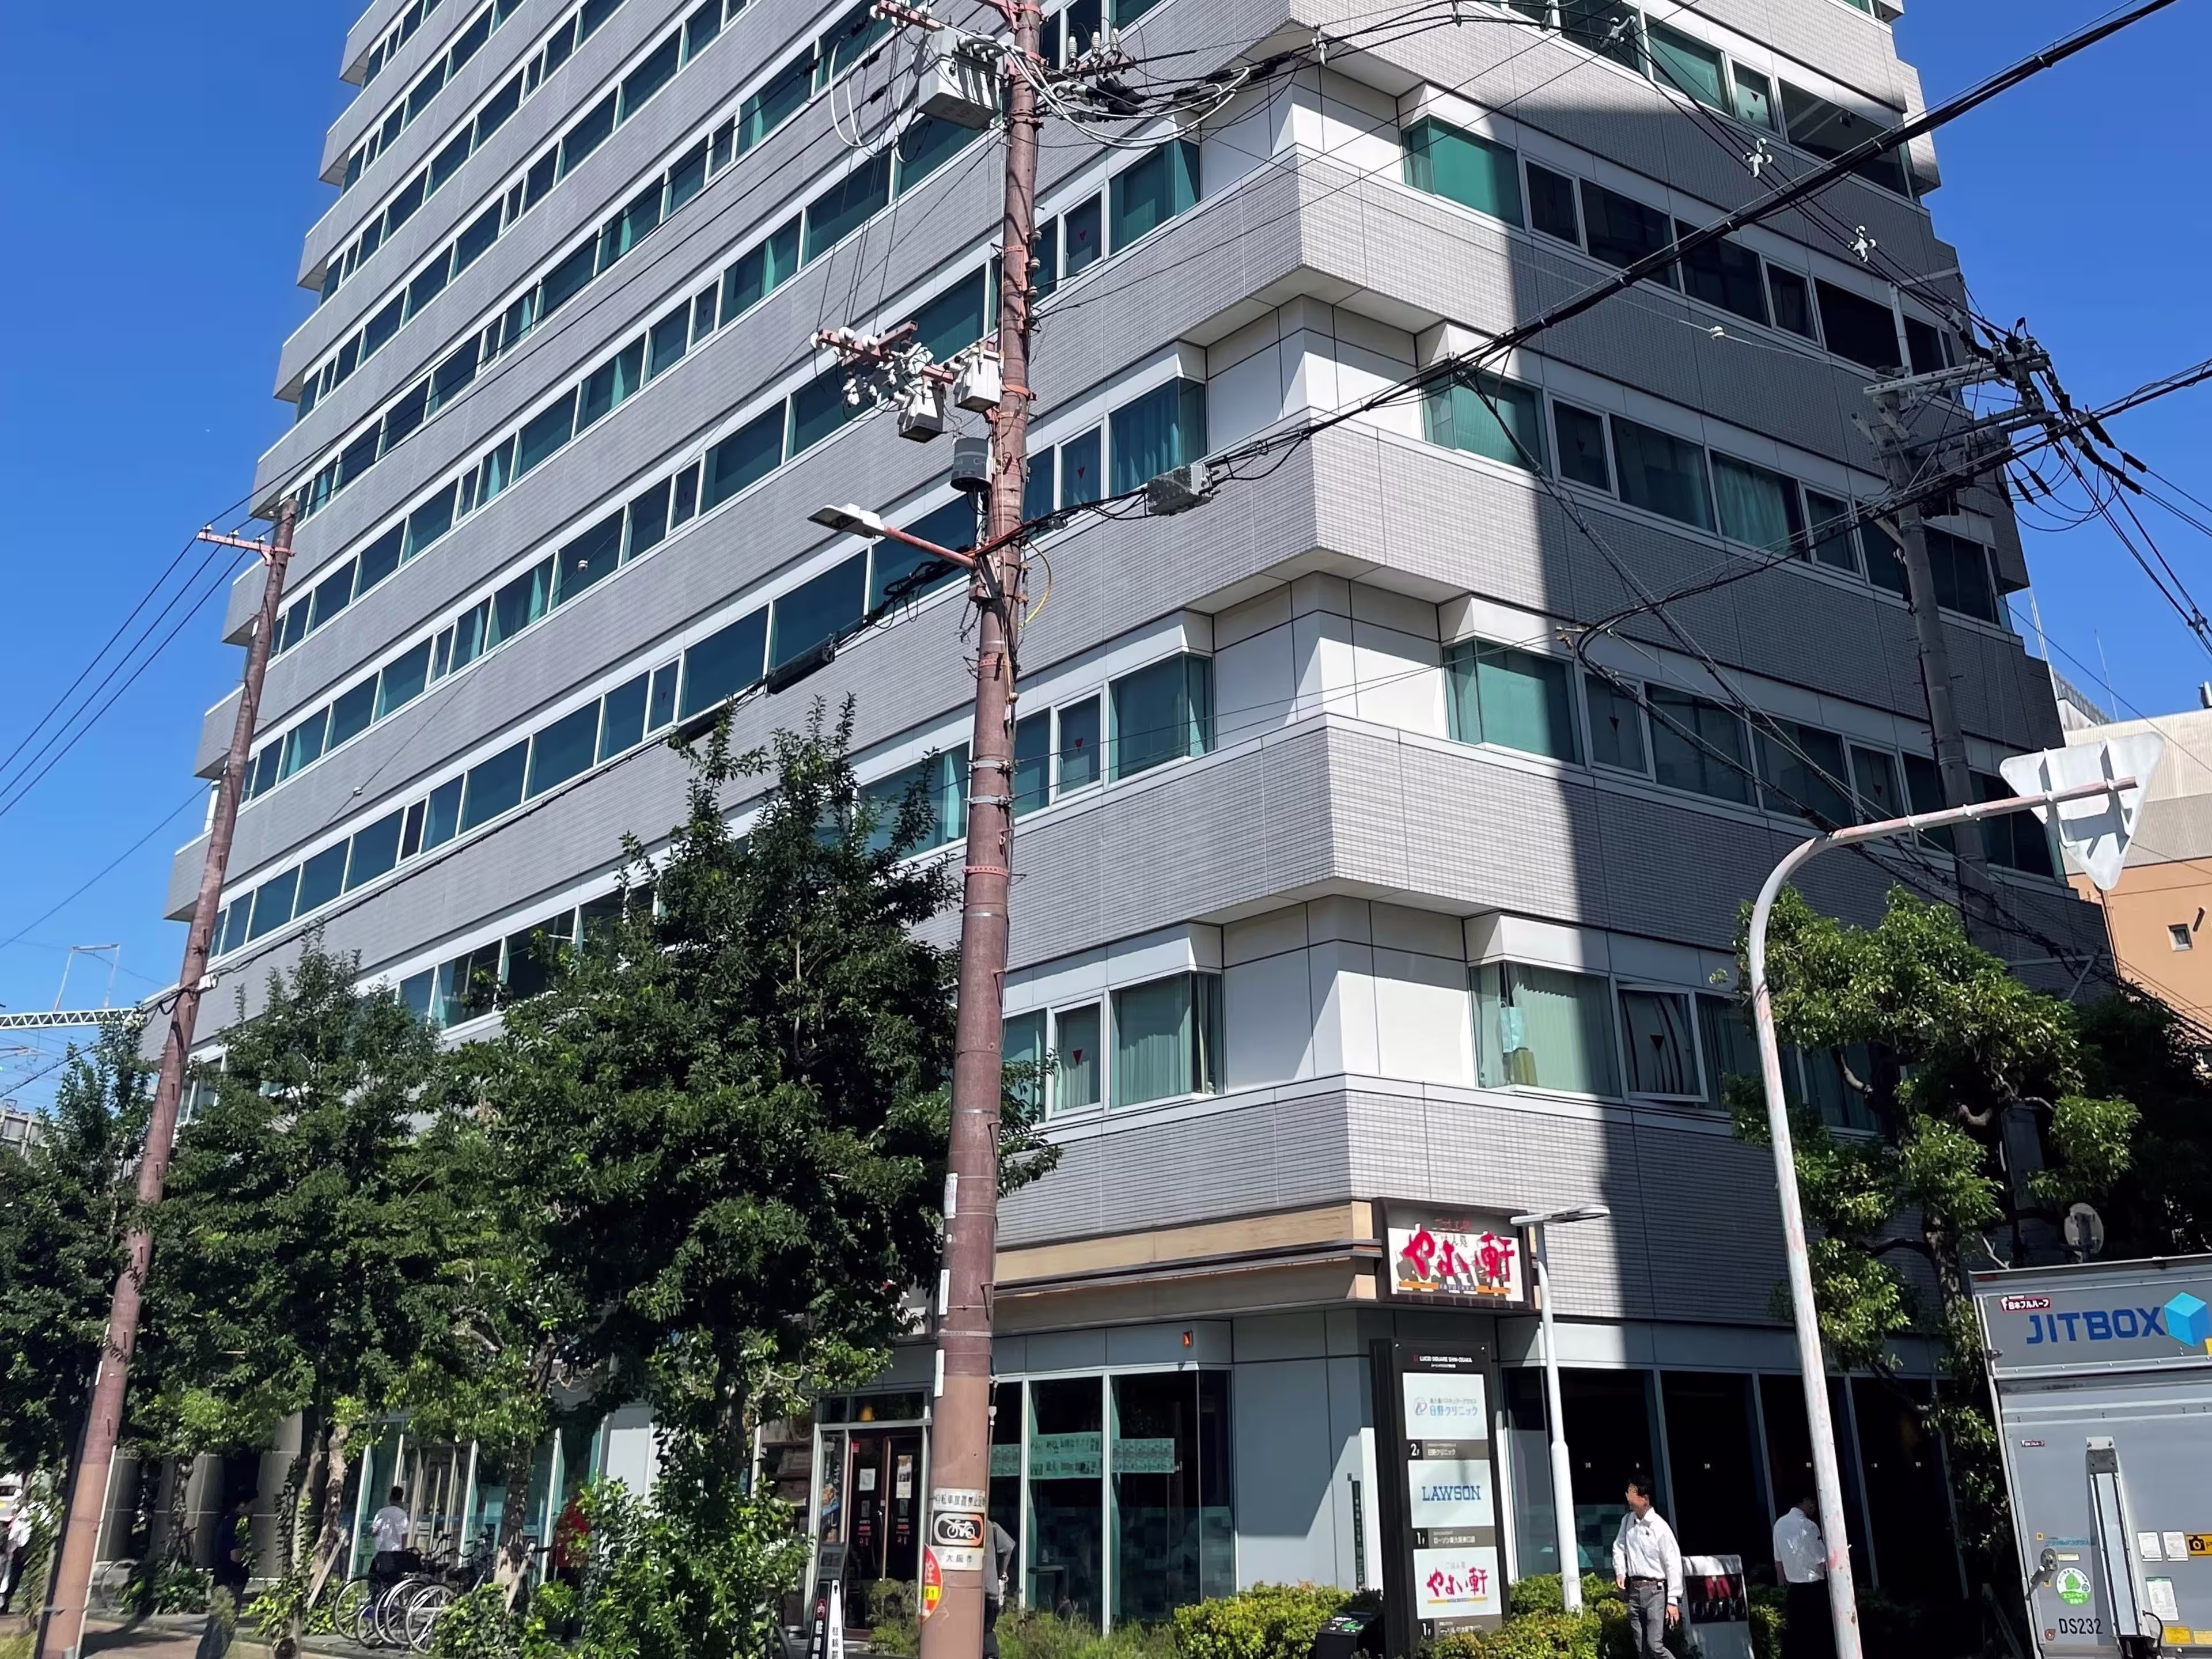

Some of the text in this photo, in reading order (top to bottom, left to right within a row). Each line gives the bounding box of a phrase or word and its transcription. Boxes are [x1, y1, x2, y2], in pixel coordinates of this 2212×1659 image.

[1402, 1227, 1515, 1288] やよい軒
[2008, 1299, 2049, 1310] 日本フルハーフ
[2026, 1306, 2166, 1344] JITBOX
[1422, 1486, 1481, 1501] LAWSON
[1427, 1567, 1488, 1597] やよい軒
[2058, 1618, 2104, 1635] DS232
